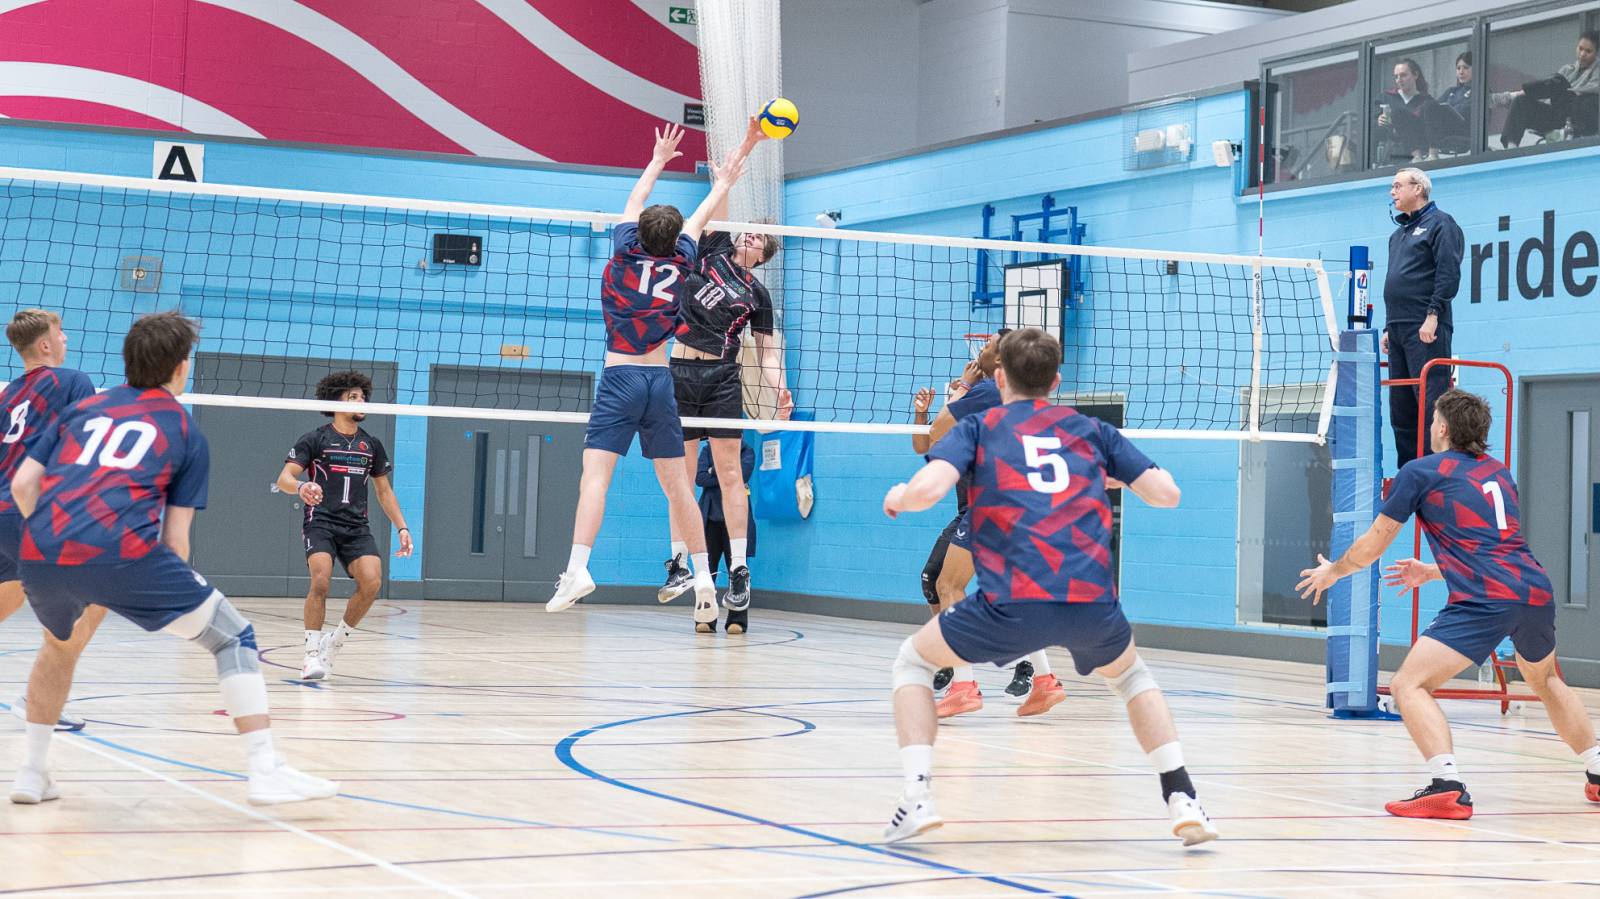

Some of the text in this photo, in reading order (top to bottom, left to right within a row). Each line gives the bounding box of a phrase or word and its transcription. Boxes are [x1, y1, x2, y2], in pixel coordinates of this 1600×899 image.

[158, 145, 197, 182] A
[1470, 209, 1600, 304] ride
[636, 260, 680, 302] 12
[694, 279, 725, 310] 18
[2, 400, 31, 443] 8
[75, 416, 157, 469] 10
[1022, 434, 1070, 494] 5
[341, 476, 350, 503] 1
[1482, 481, 1508, 530] 1
